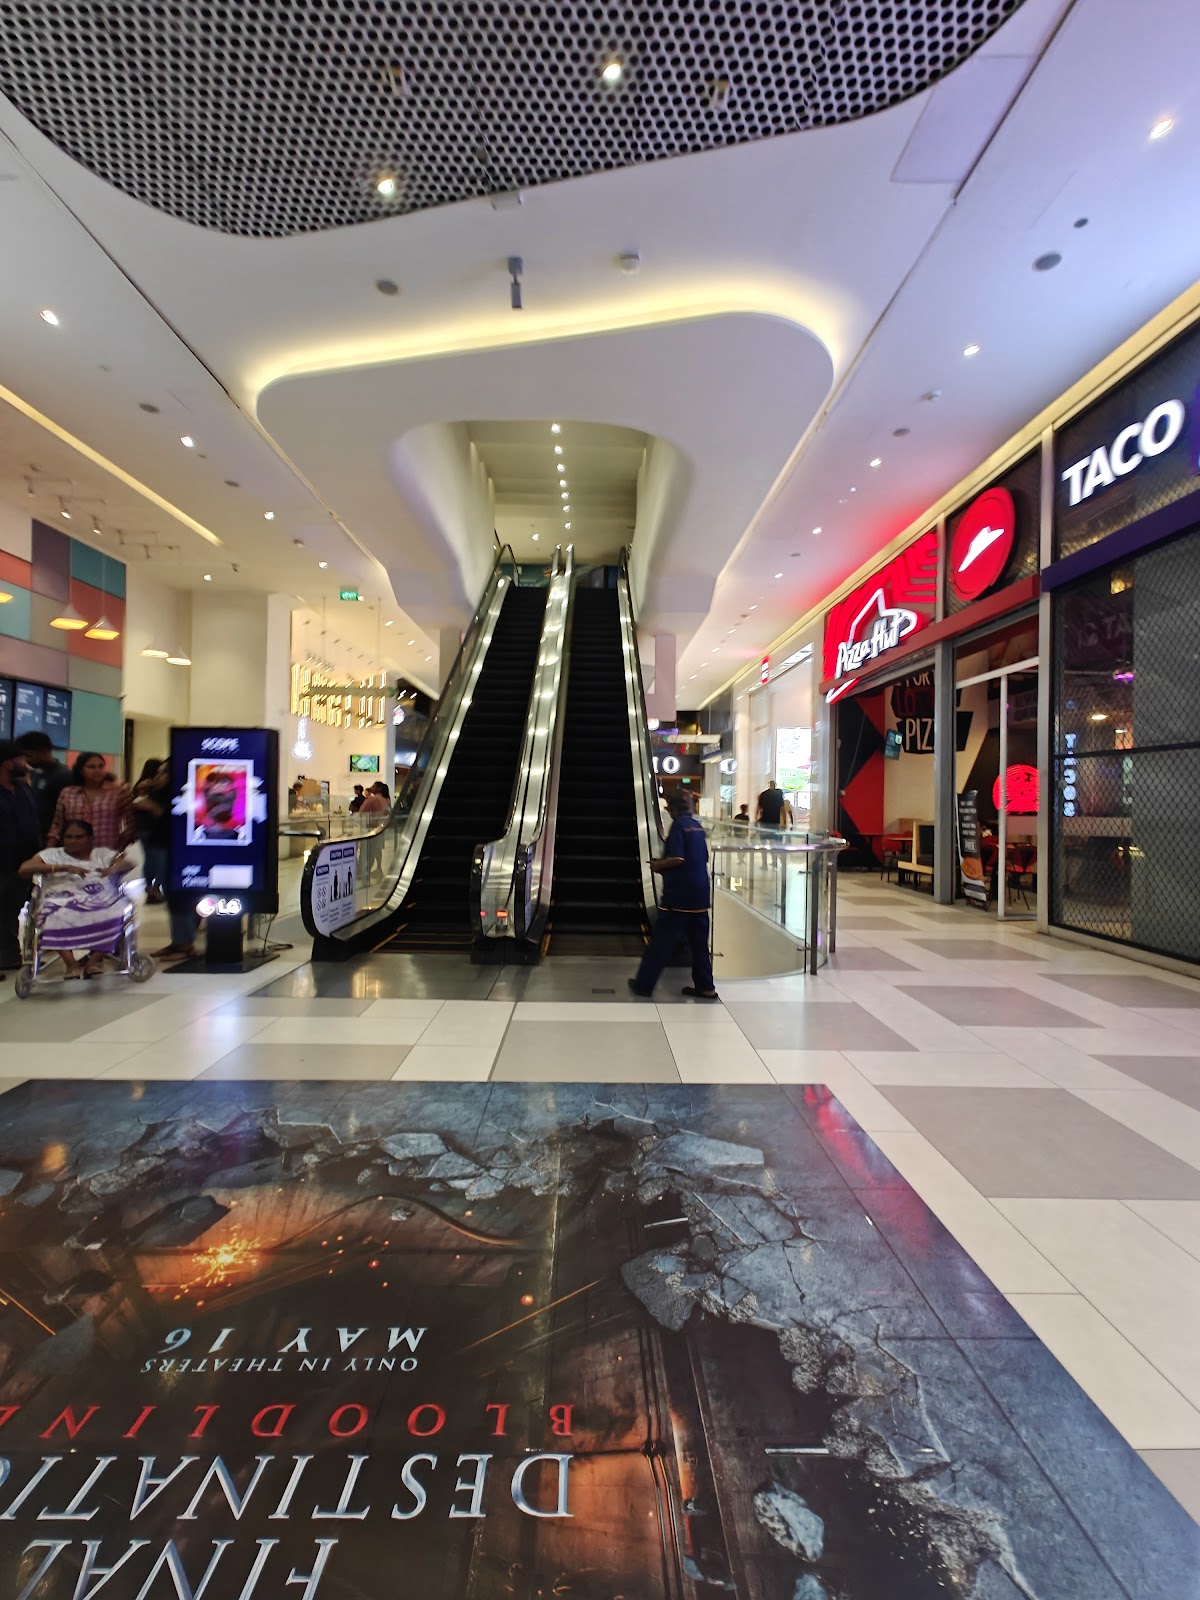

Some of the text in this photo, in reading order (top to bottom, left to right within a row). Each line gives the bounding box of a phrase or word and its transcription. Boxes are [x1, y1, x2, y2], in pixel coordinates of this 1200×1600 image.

[1061, 399, 1185, 507] TACO
[835, 612, 905, 680] Pizza Hut
[905, 718, 934, 752] PIZ
[216, 897, 242, 916] LG
[157, 1327, 427, 1354] MAY 16
[140, 1357, 418, 1373] ONLY IN THEATERS
[0, 1453, 574, 1522] DESTINATI
[15, 1538, 339, 1600] FINAL
